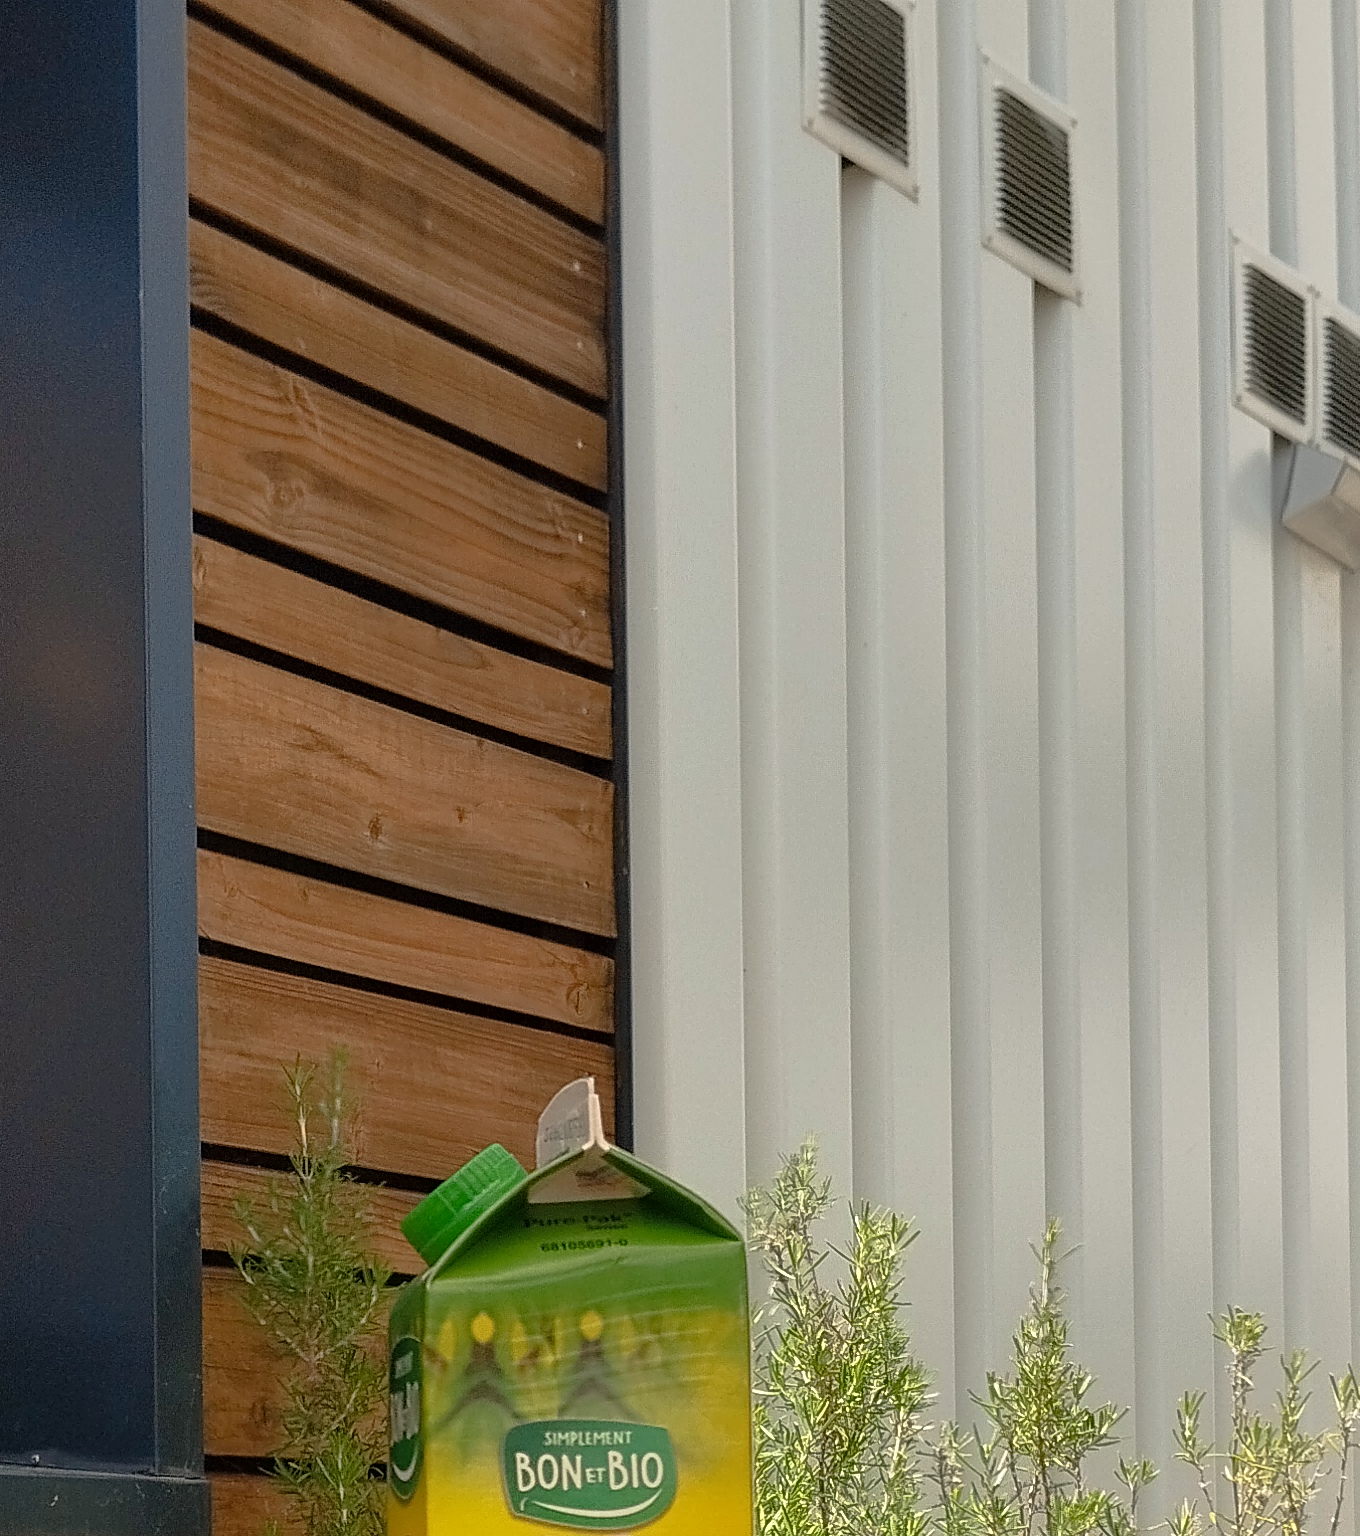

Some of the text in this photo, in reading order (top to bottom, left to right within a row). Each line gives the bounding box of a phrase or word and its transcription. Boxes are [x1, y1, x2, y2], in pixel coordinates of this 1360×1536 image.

[544, 1430, 633, 1446] SIMPLEMENT
[515, 1450, 664, 1493] BON ET BIO
